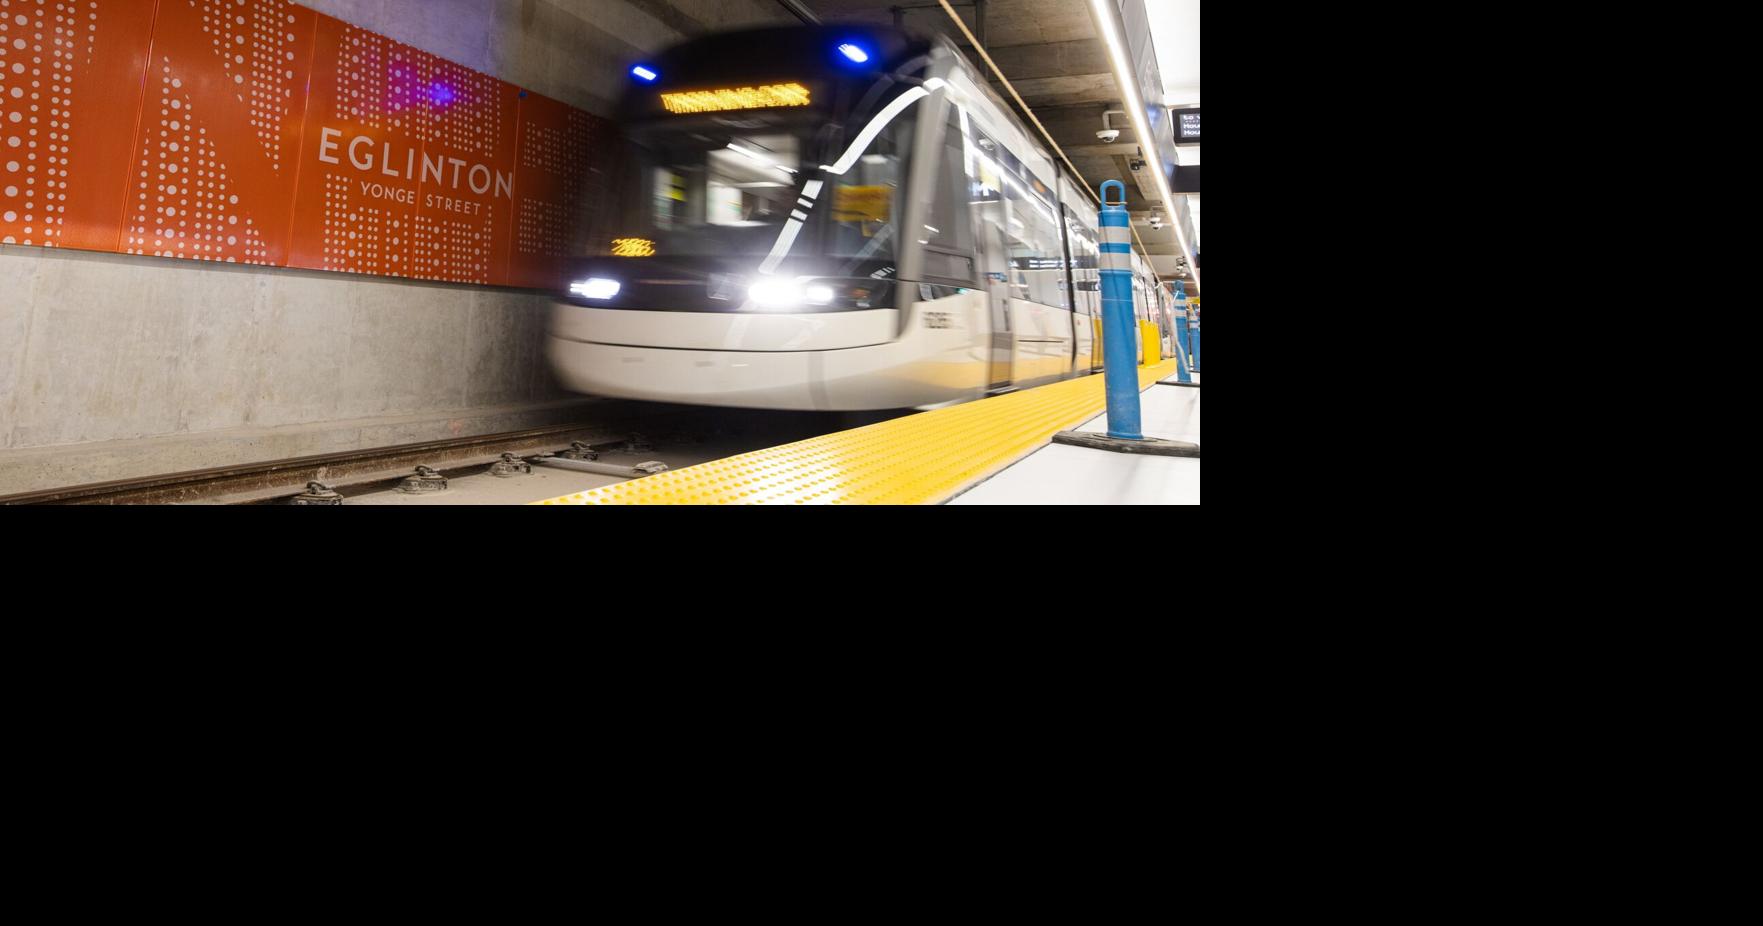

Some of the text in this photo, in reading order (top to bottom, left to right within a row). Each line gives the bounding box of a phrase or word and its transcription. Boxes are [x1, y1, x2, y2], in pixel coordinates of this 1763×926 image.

[319, 127, 513, 200] EGLINTON
[360, 181, 481, 215] YONGE STREET
